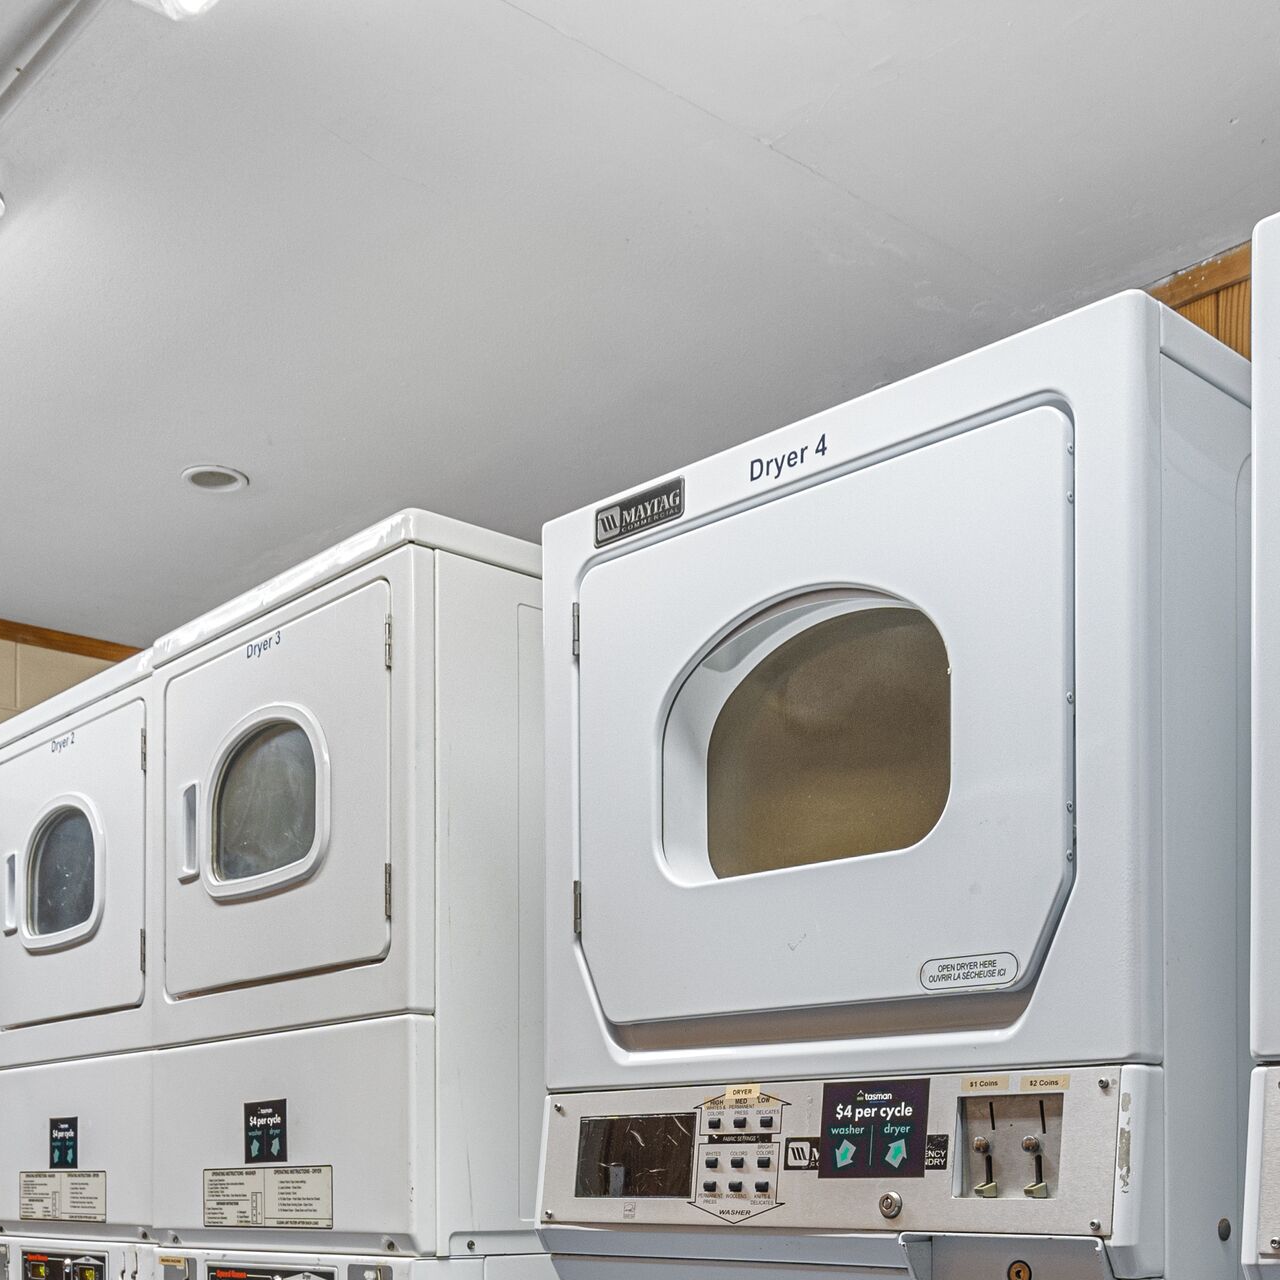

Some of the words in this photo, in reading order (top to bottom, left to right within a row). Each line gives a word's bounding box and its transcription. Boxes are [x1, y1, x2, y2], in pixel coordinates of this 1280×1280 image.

[750, 445, 808, 482] Dryer
[815, 433, 827, 456] 4
[621, 488, 680, 527] MAYTAG
[621, 507, 679, 533] COMMERCIAL
[246, 637, 272, 659] Dryer
[275, 630, 281, 645] 3
[937, 964, 955, 973] OPEN
[956, 961, 978, 971] DRYER
[979, 960, 997, 968] HERE
[928, 973, 952, 983] OUVRIR
[953, 973, 961, 981] LA
[864, 1092, 892, 1101] tasman
[835, 1103, 852, 1120] $4
[855, 1107, 877, 1122] per
[880, 1102, 913, 1121] cycle
[830, 1124, 865, 1135] washer
[883, 1123, 911, 1136] dryer
[925, 1158, 946, 1166] DRY
